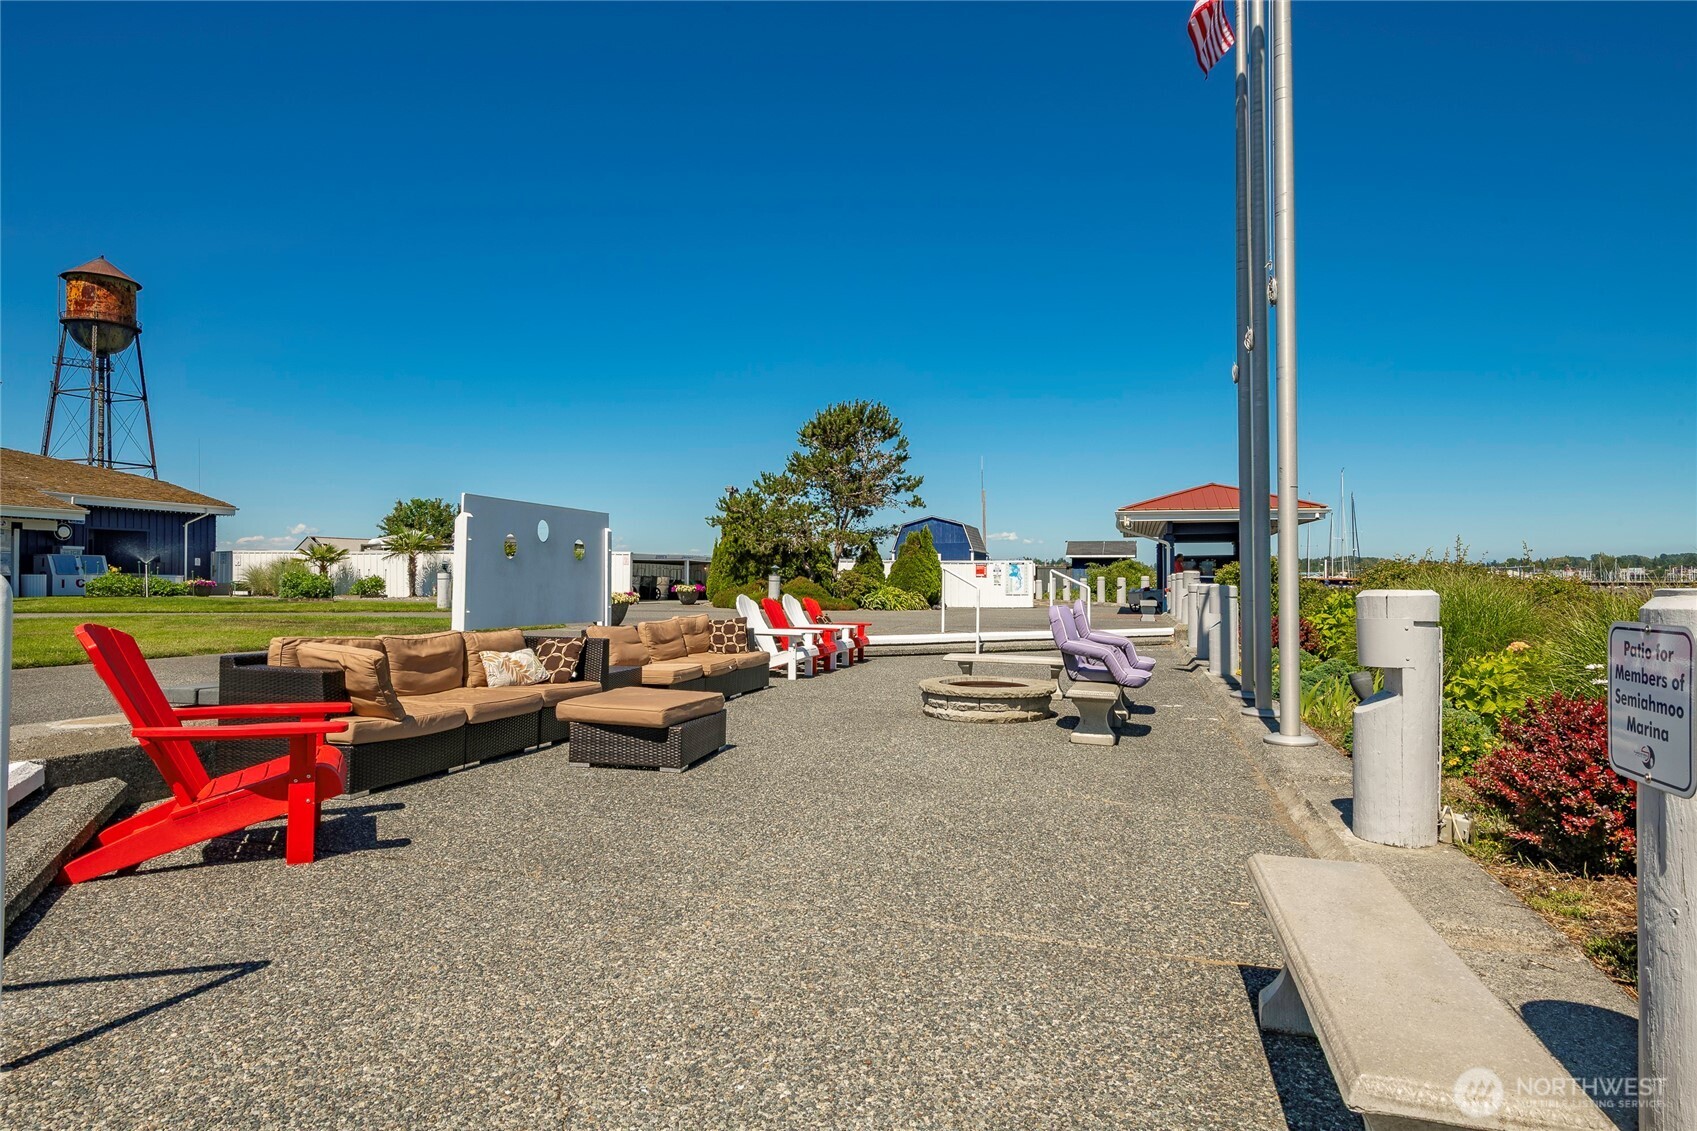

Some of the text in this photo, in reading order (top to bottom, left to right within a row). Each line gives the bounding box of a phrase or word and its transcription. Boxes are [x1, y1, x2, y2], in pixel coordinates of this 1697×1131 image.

[1623, 640, 1675, 663] Patio for
[1615, 664, 1686, 692] Members of
[1615, 688, 1685, 719] Semiahmoo
[1626, 715, 1669, 742] Marina
